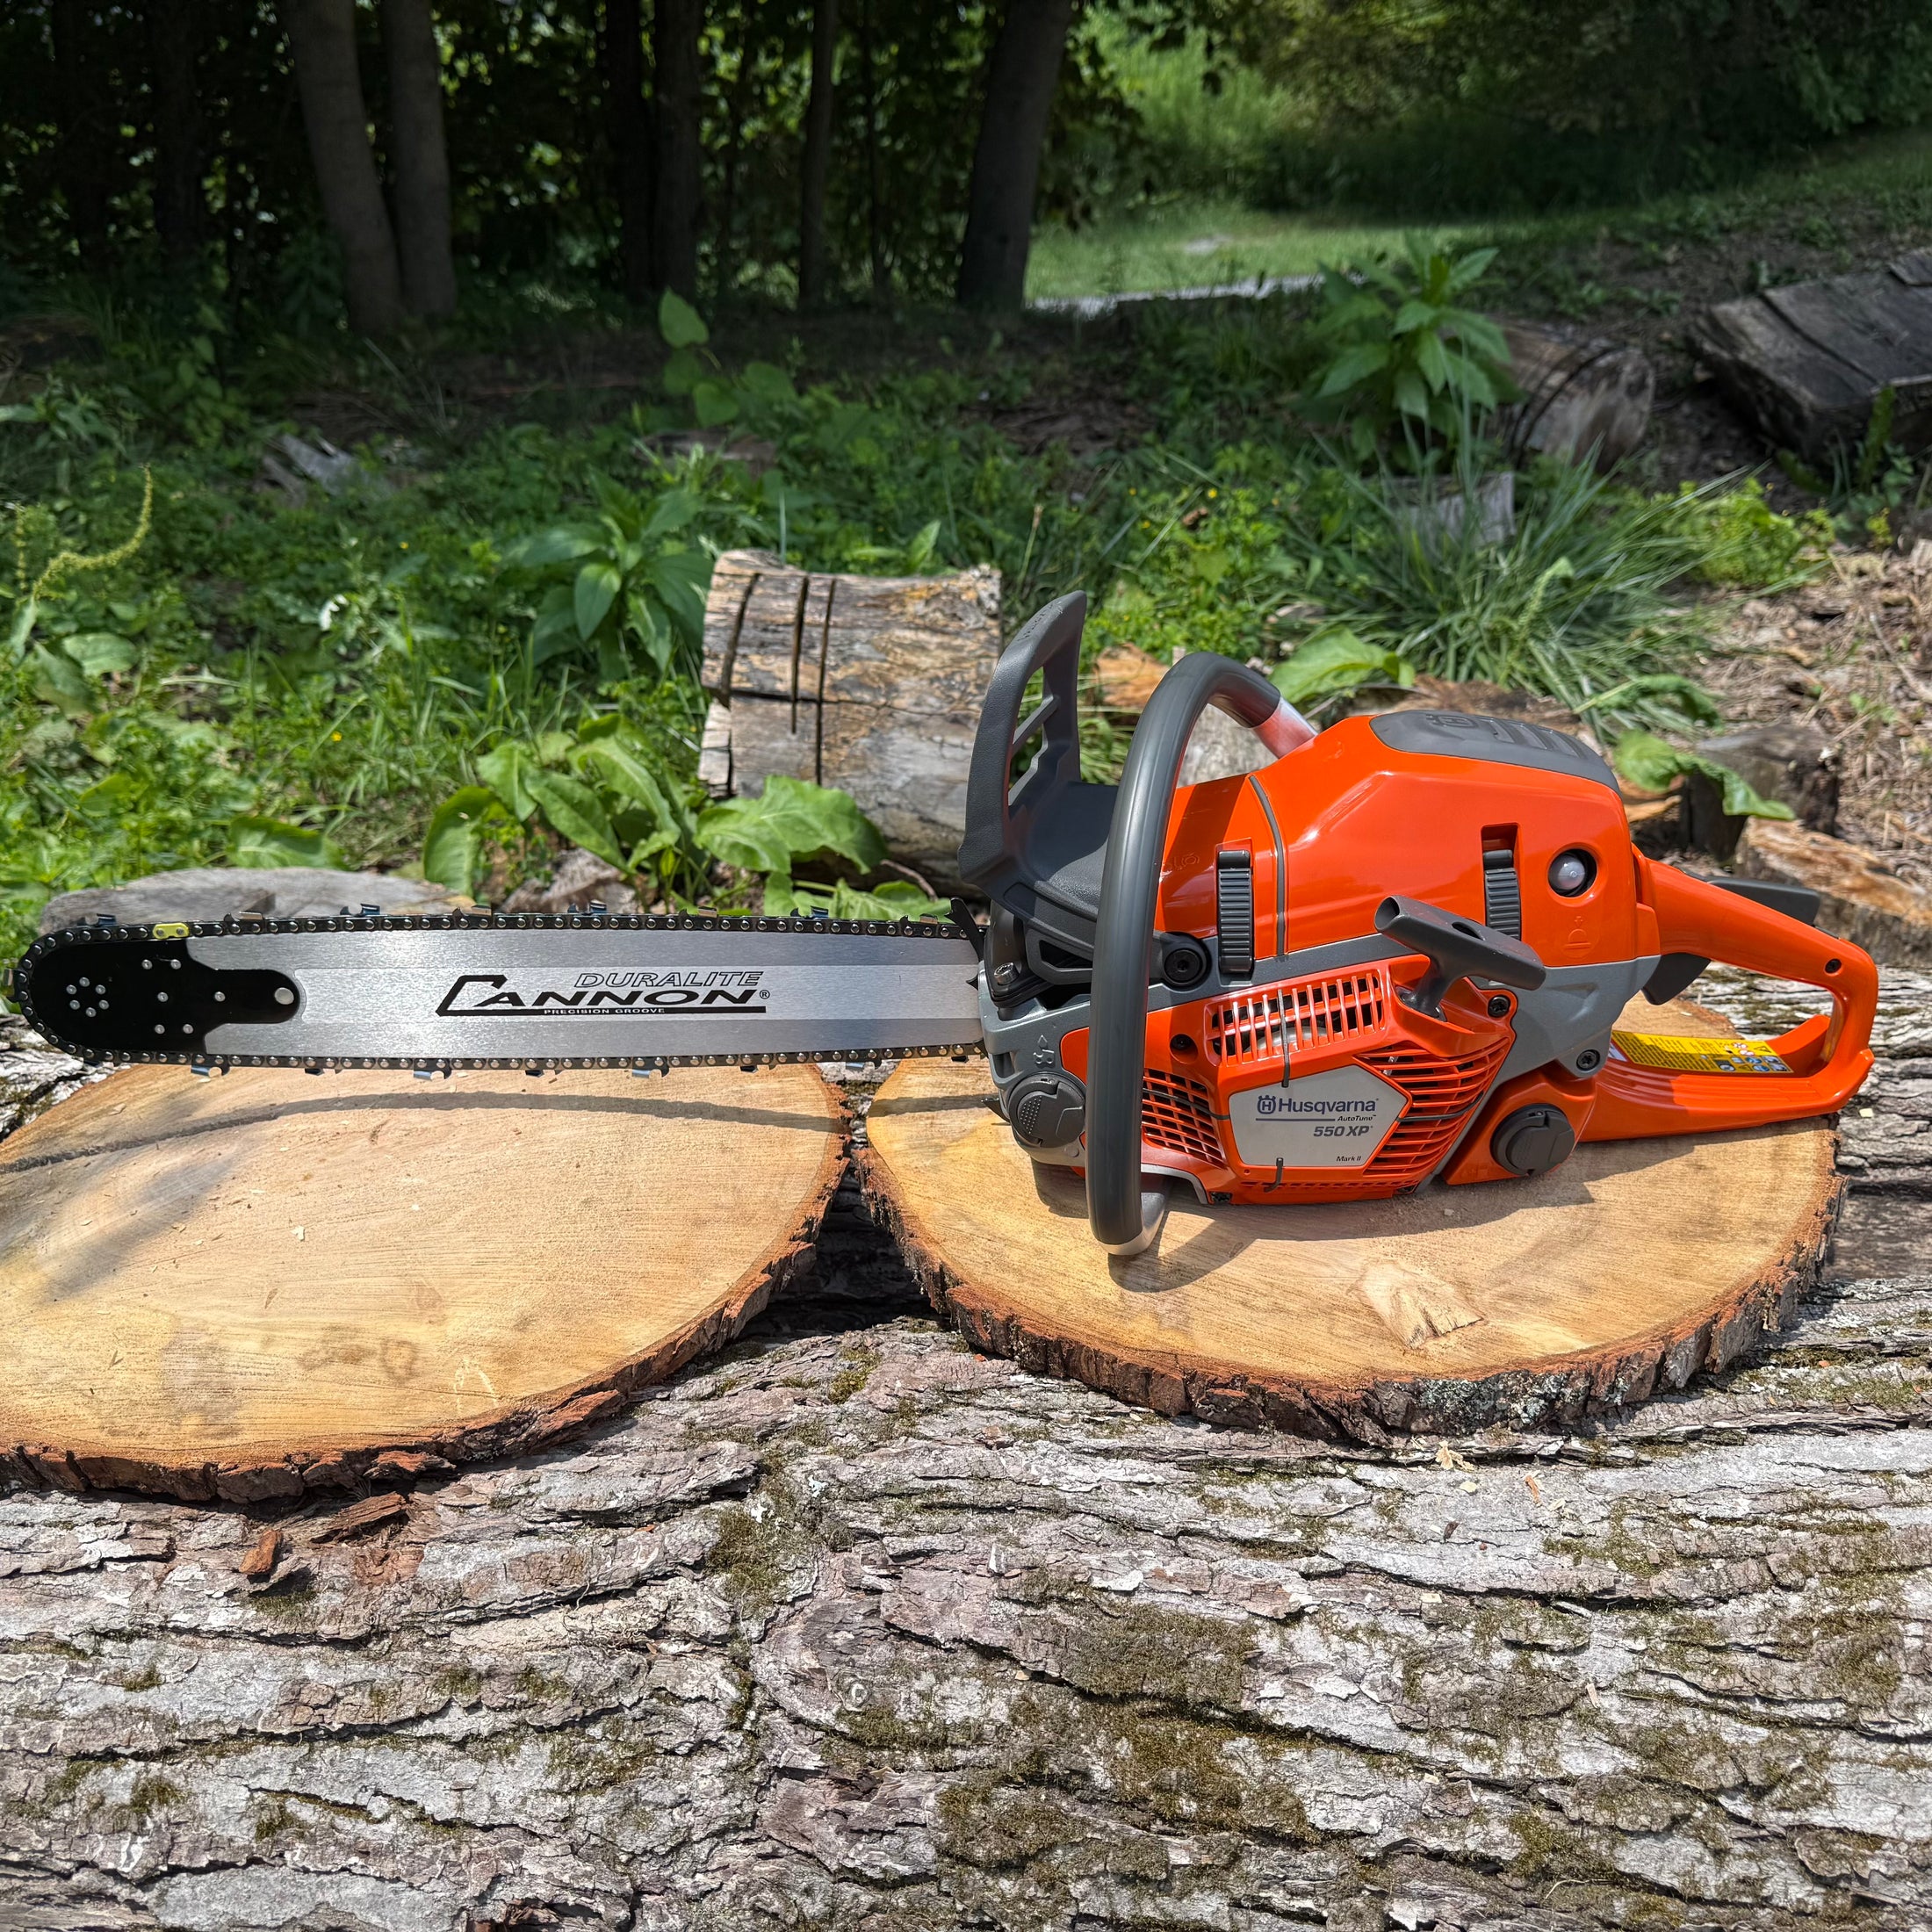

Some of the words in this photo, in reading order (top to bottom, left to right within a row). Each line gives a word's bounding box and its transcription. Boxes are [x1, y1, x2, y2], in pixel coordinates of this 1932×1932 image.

[574, 971, 764, 988] DURALITE
[436, 974, 767, 1017] CANNON
[1278, 1098, 1376, 1114] Husqvarna
[1313, 1126, 1345, 1137] 550
[1345, 1126, 1370, 1136] XP
